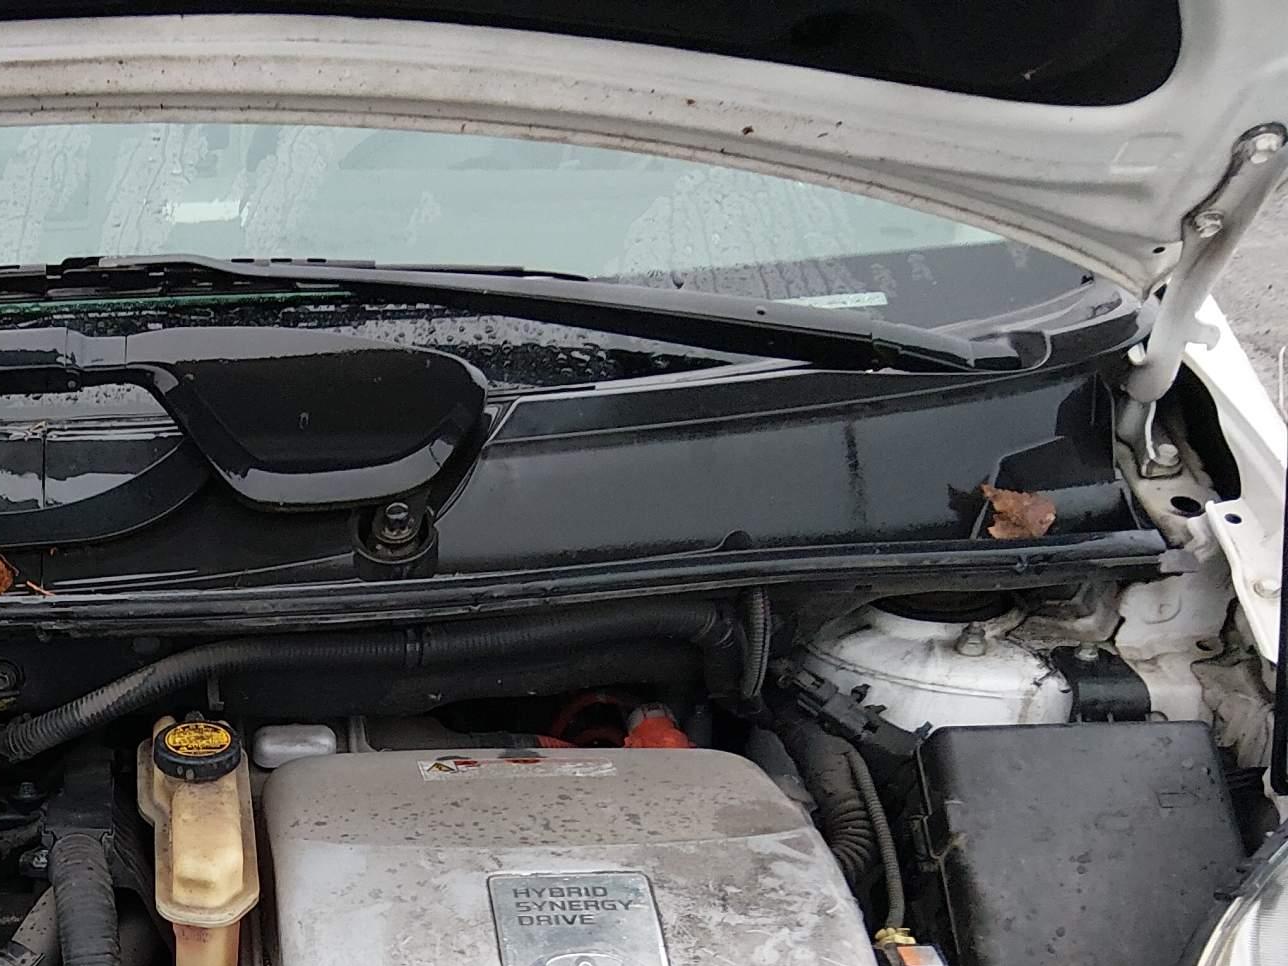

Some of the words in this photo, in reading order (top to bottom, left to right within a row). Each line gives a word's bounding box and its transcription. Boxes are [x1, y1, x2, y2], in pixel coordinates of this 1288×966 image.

[512, 886, 608, 898] HYBRID
[515, 899, 633, 912] SYNERGY
[517, 914, 596, 926] DRIVE
